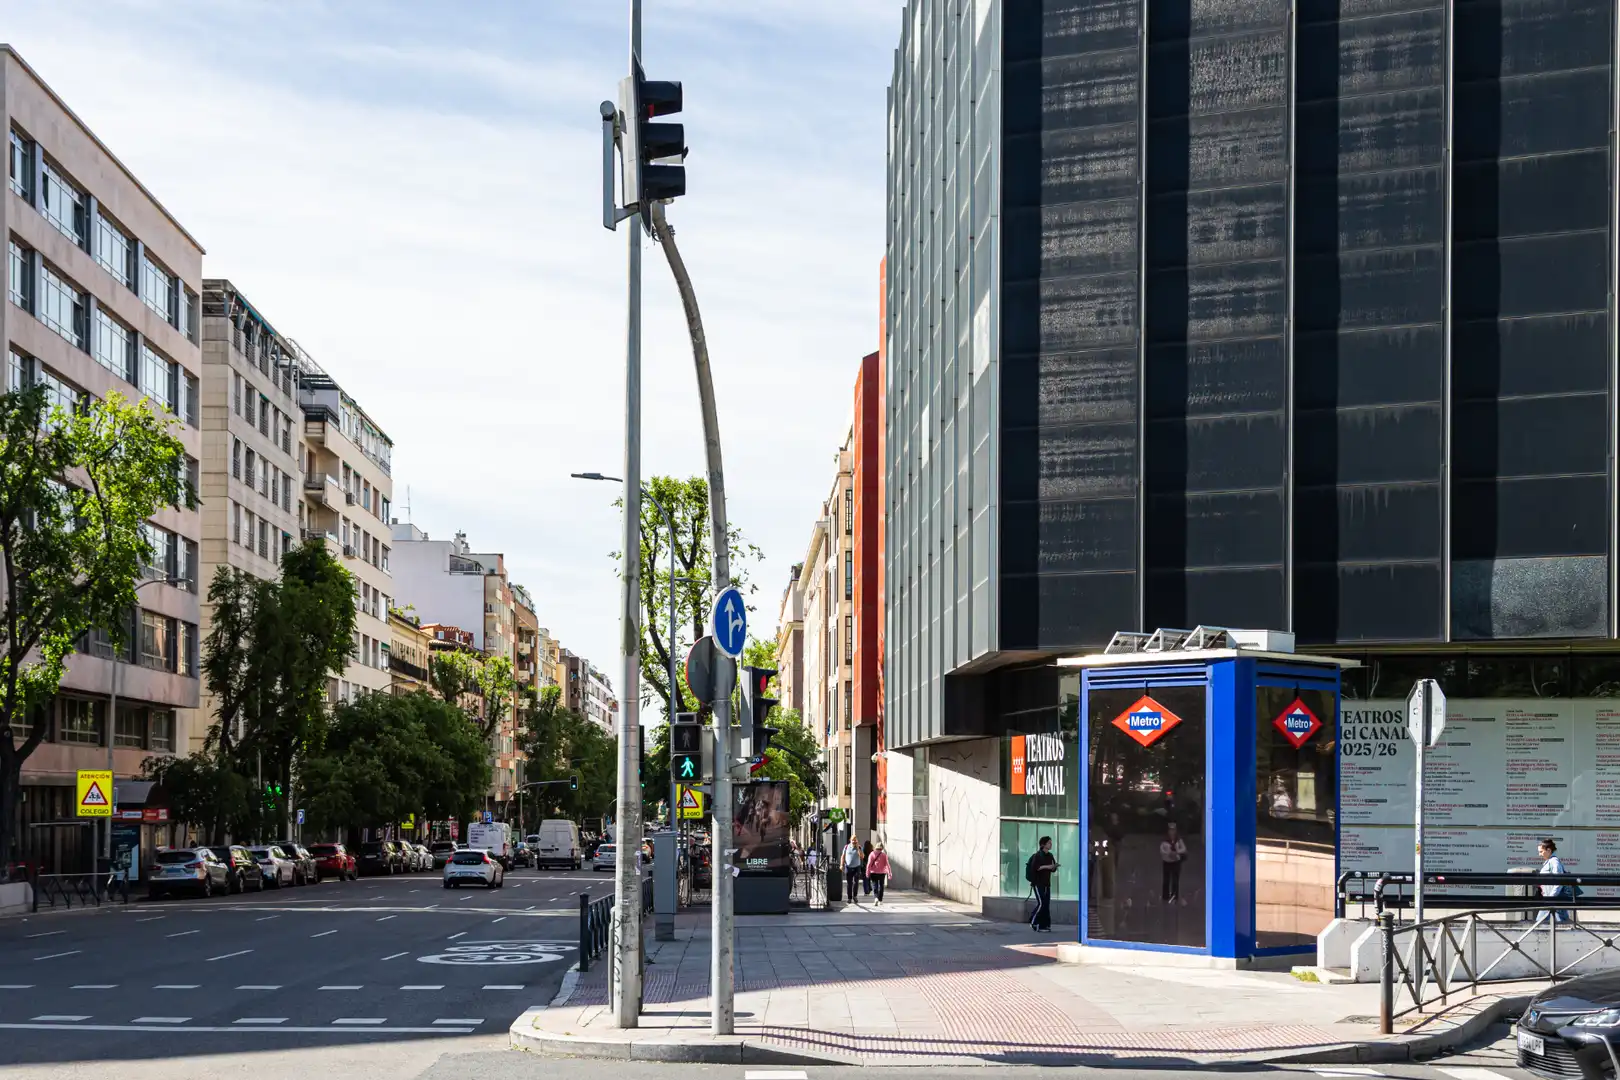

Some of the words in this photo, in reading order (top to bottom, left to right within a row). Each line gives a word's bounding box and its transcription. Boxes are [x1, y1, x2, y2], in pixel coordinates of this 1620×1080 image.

[1131, 716, 1159, 726] Metro
[1288, 718, 1308, 728] Metro
[1359, 726, 1409, 740] CANAL
[1025, 731, 1065, 762] TEATROS
[1340, 742, 1397, 760] 025/26
[451, 954, 532, 962] 30
